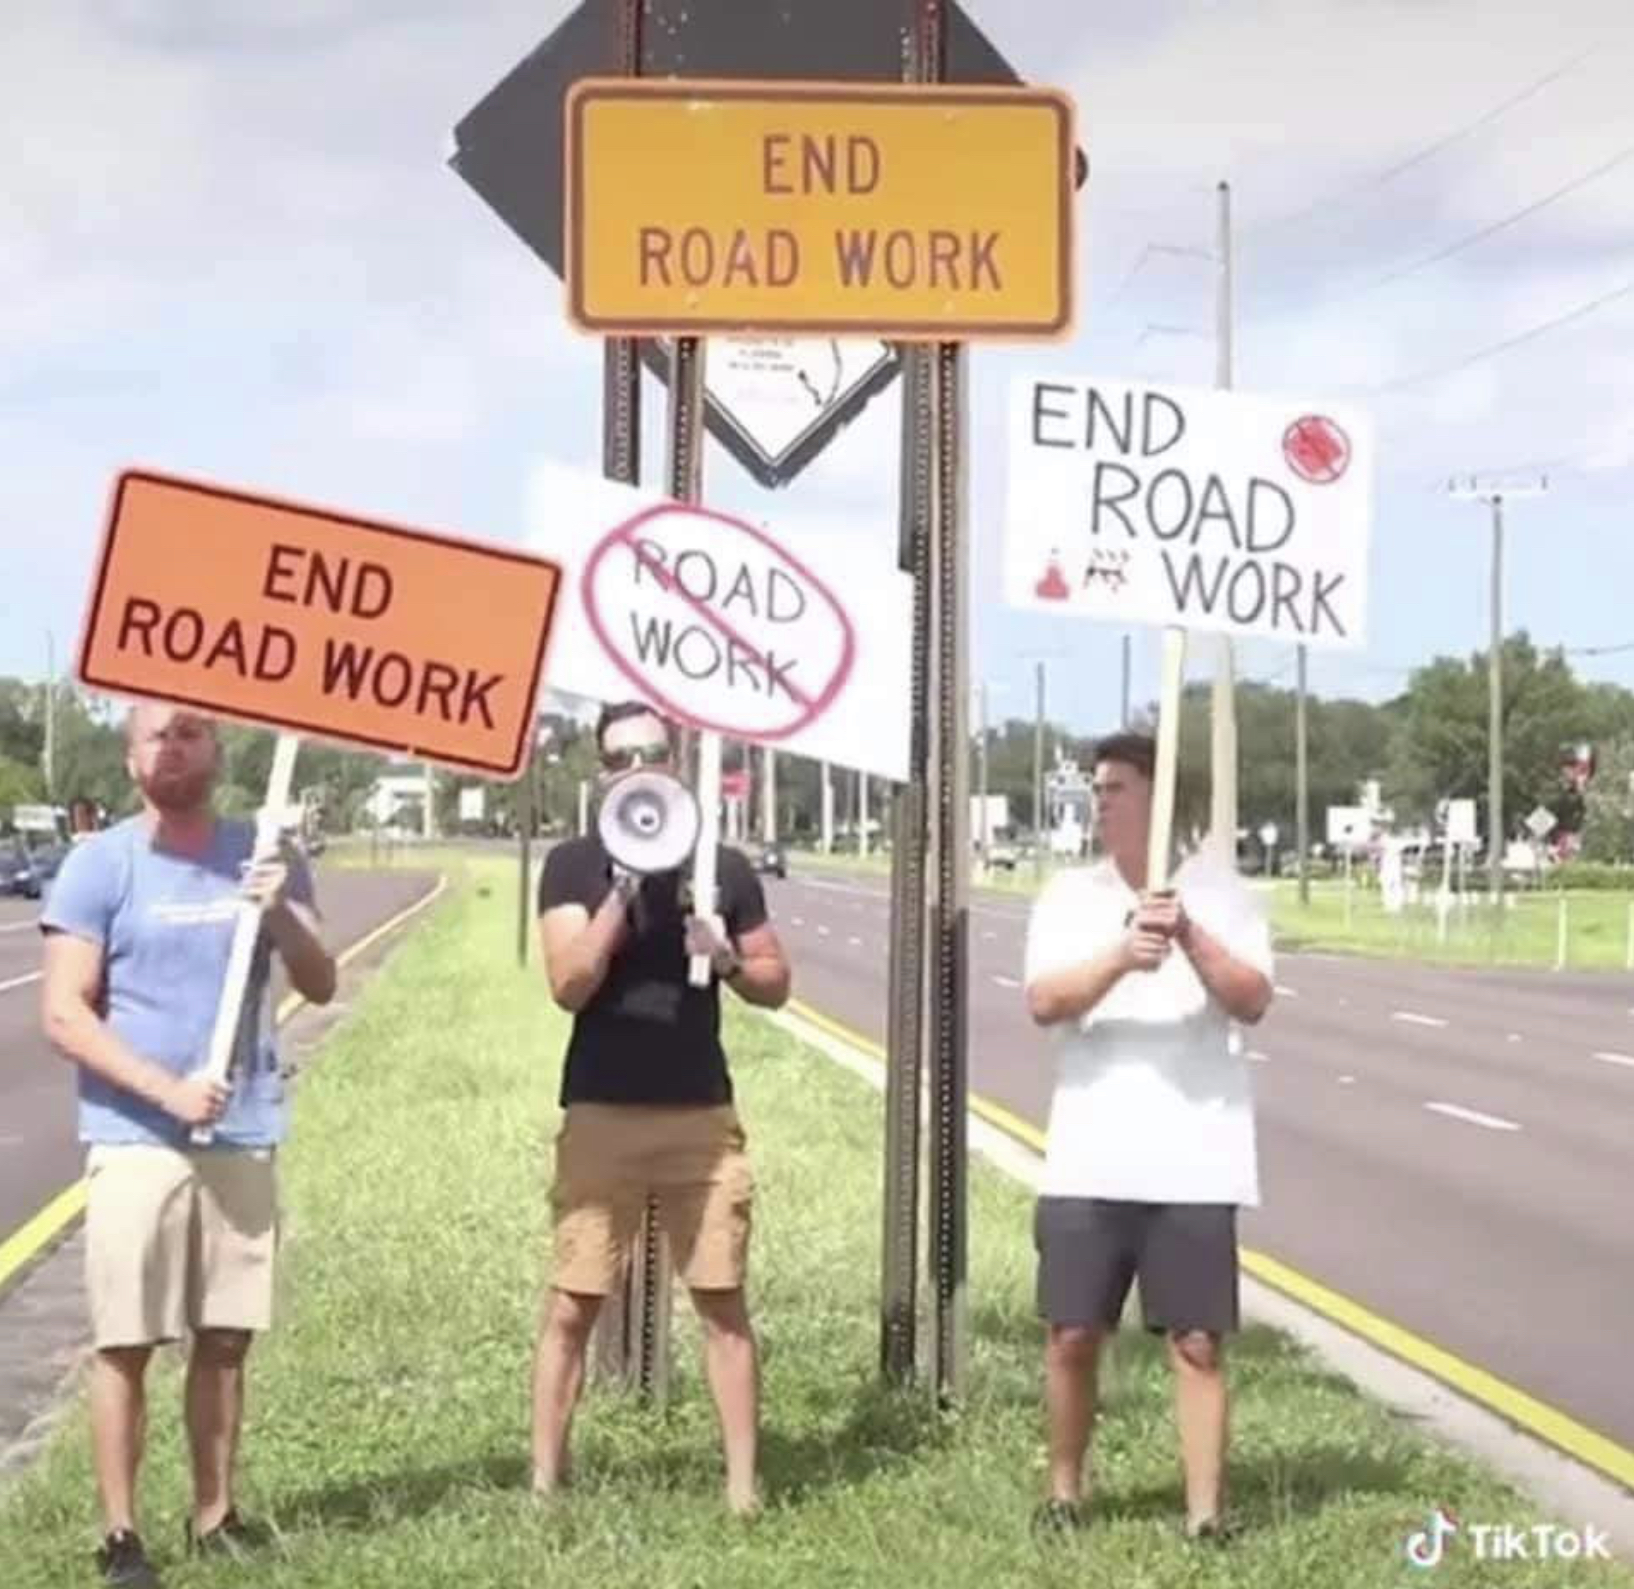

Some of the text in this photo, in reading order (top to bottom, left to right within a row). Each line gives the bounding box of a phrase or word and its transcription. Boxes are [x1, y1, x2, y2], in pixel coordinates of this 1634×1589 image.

[763, 134, 881, 195] END
[638, 227, 1002, 291] ROAD WORK
[1033, 382, 1186, 458] END
[1091, 461, 1295, 553] ROAD
[263, 543, 393, 619] END
[633, 538, 806, 623] ROAD
[1160, 549, 1346, 637] WORK
[117, 596, 504, 730] ROAD WORK
[630, 610, 798, 698] WORK
